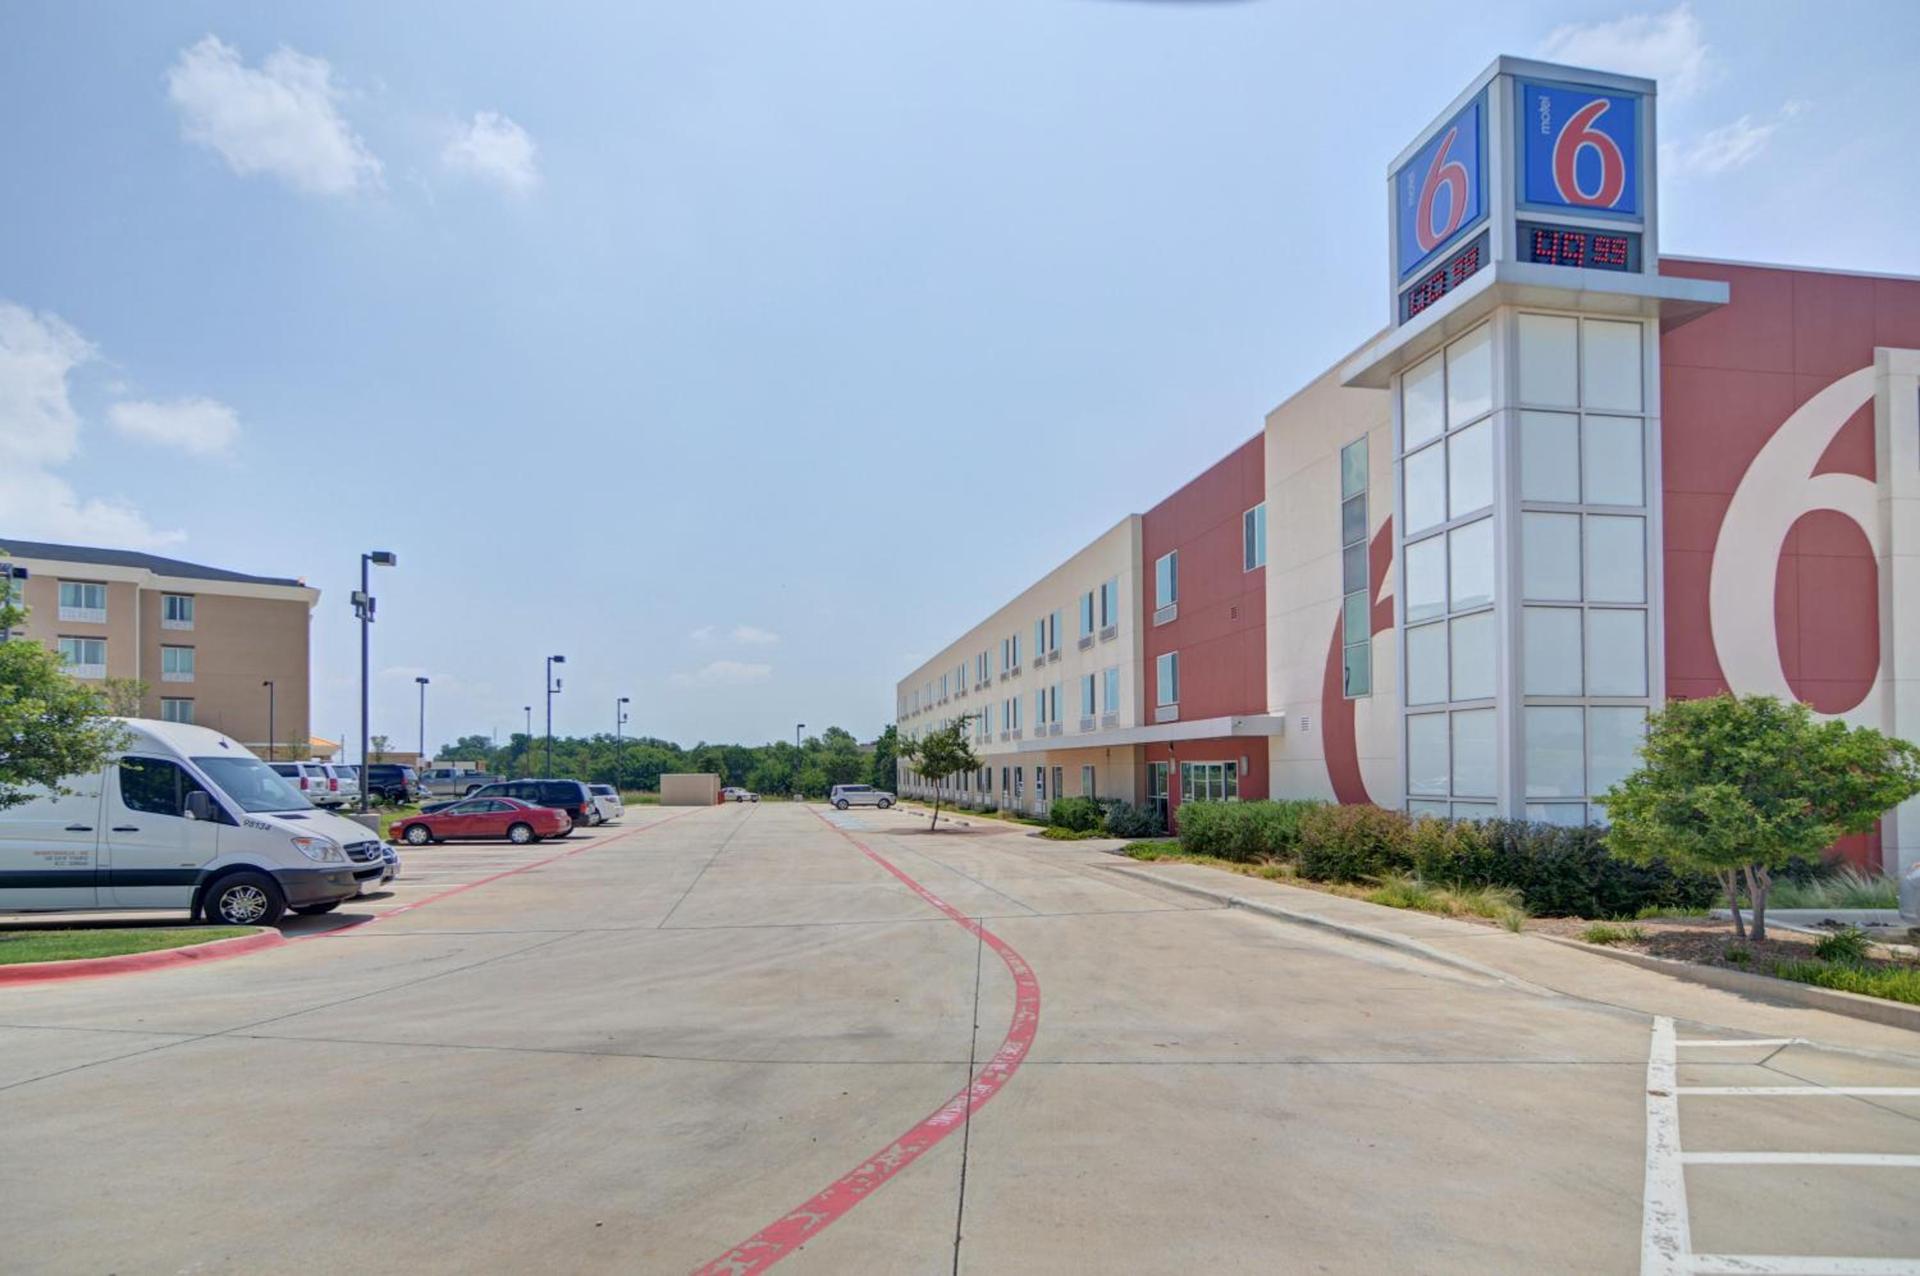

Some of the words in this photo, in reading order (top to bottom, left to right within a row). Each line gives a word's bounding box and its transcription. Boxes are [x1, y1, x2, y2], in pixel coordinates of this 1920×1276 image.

[1537, 95, 1551, 135] motel
[1416, 126, 1469, 253] 6
[1552, 98, 1626, 209] 6
[1536, 230, 1585, 267] 49
